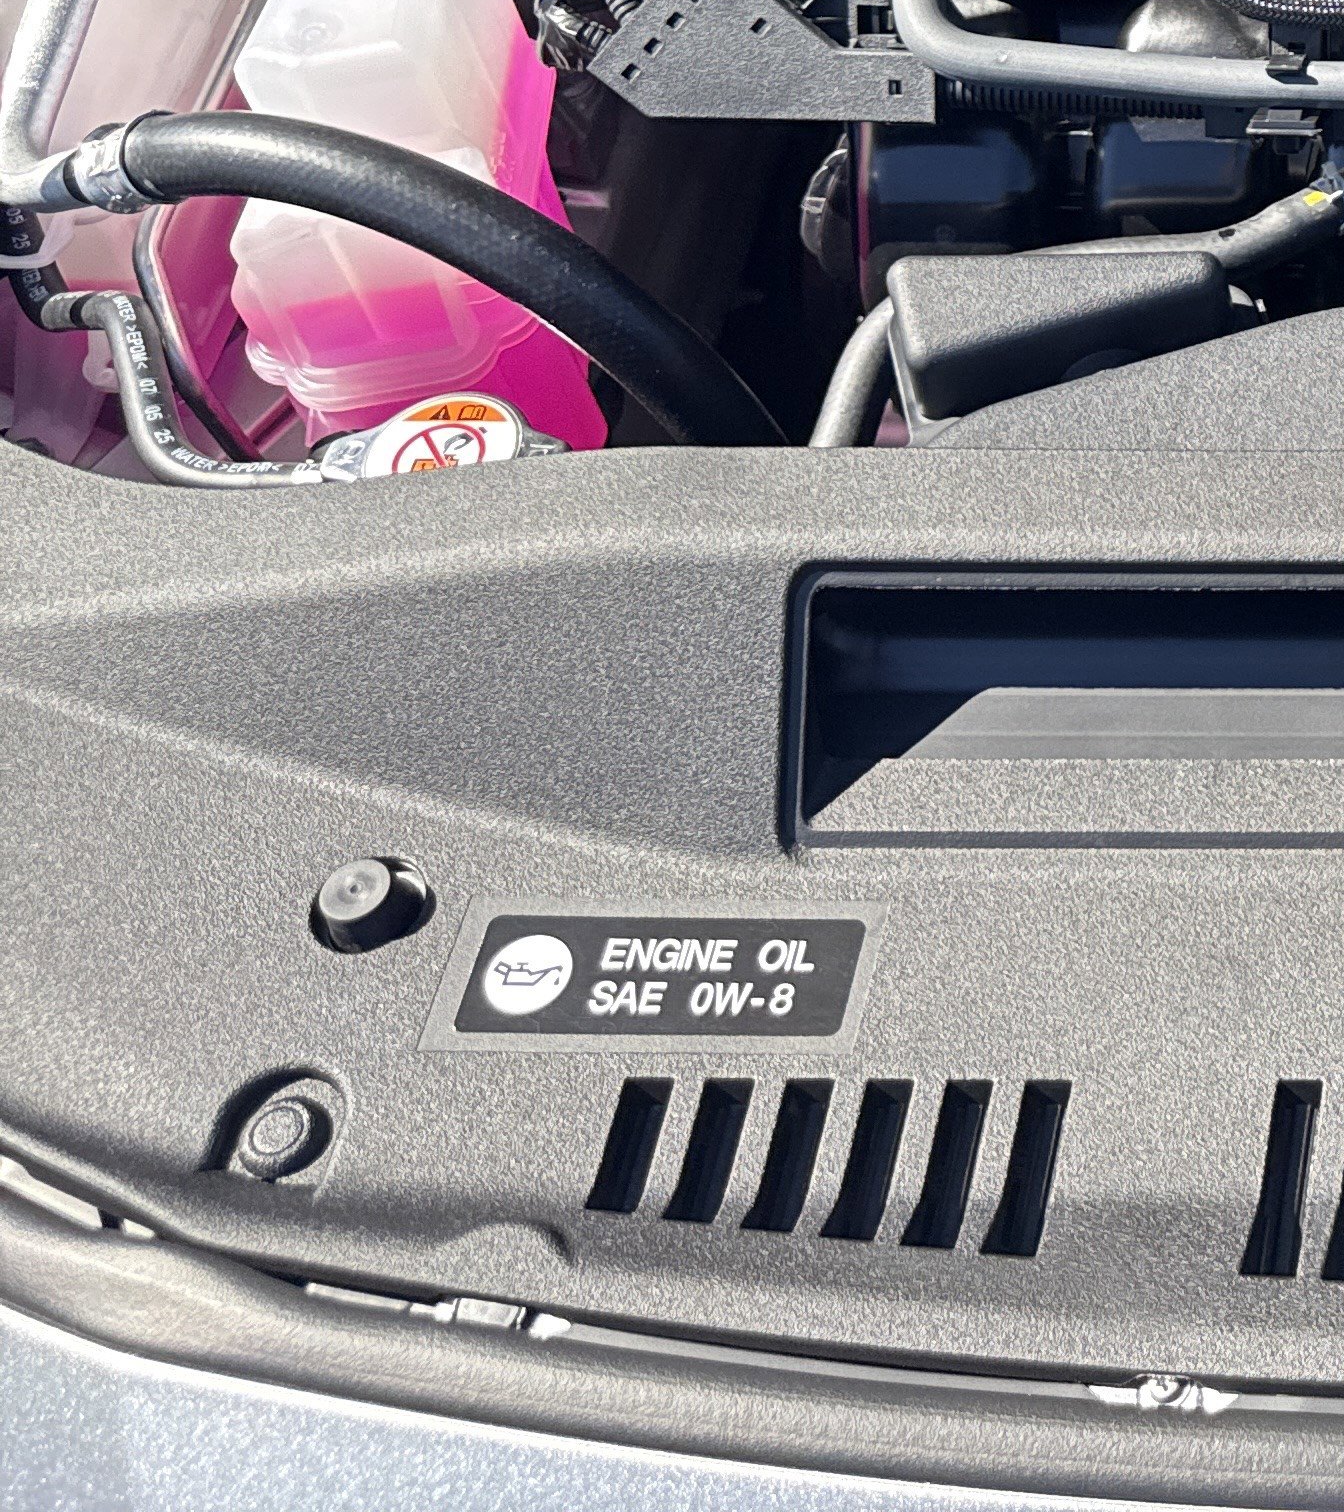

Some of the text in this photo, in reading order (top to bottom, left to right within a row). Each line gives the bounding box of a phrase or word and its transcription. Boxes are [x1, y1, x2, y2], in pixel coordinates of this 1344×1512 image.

[11, 233, 31, 249] 25
[144, 405, 164, 422] 05
[153, 428, 175, 445] 25
[170, 446, 218, 471] WATER
[600, 937, 815, 972] ENGINE OIL
[588, 980, 795, 1016] SAE 0W-8
